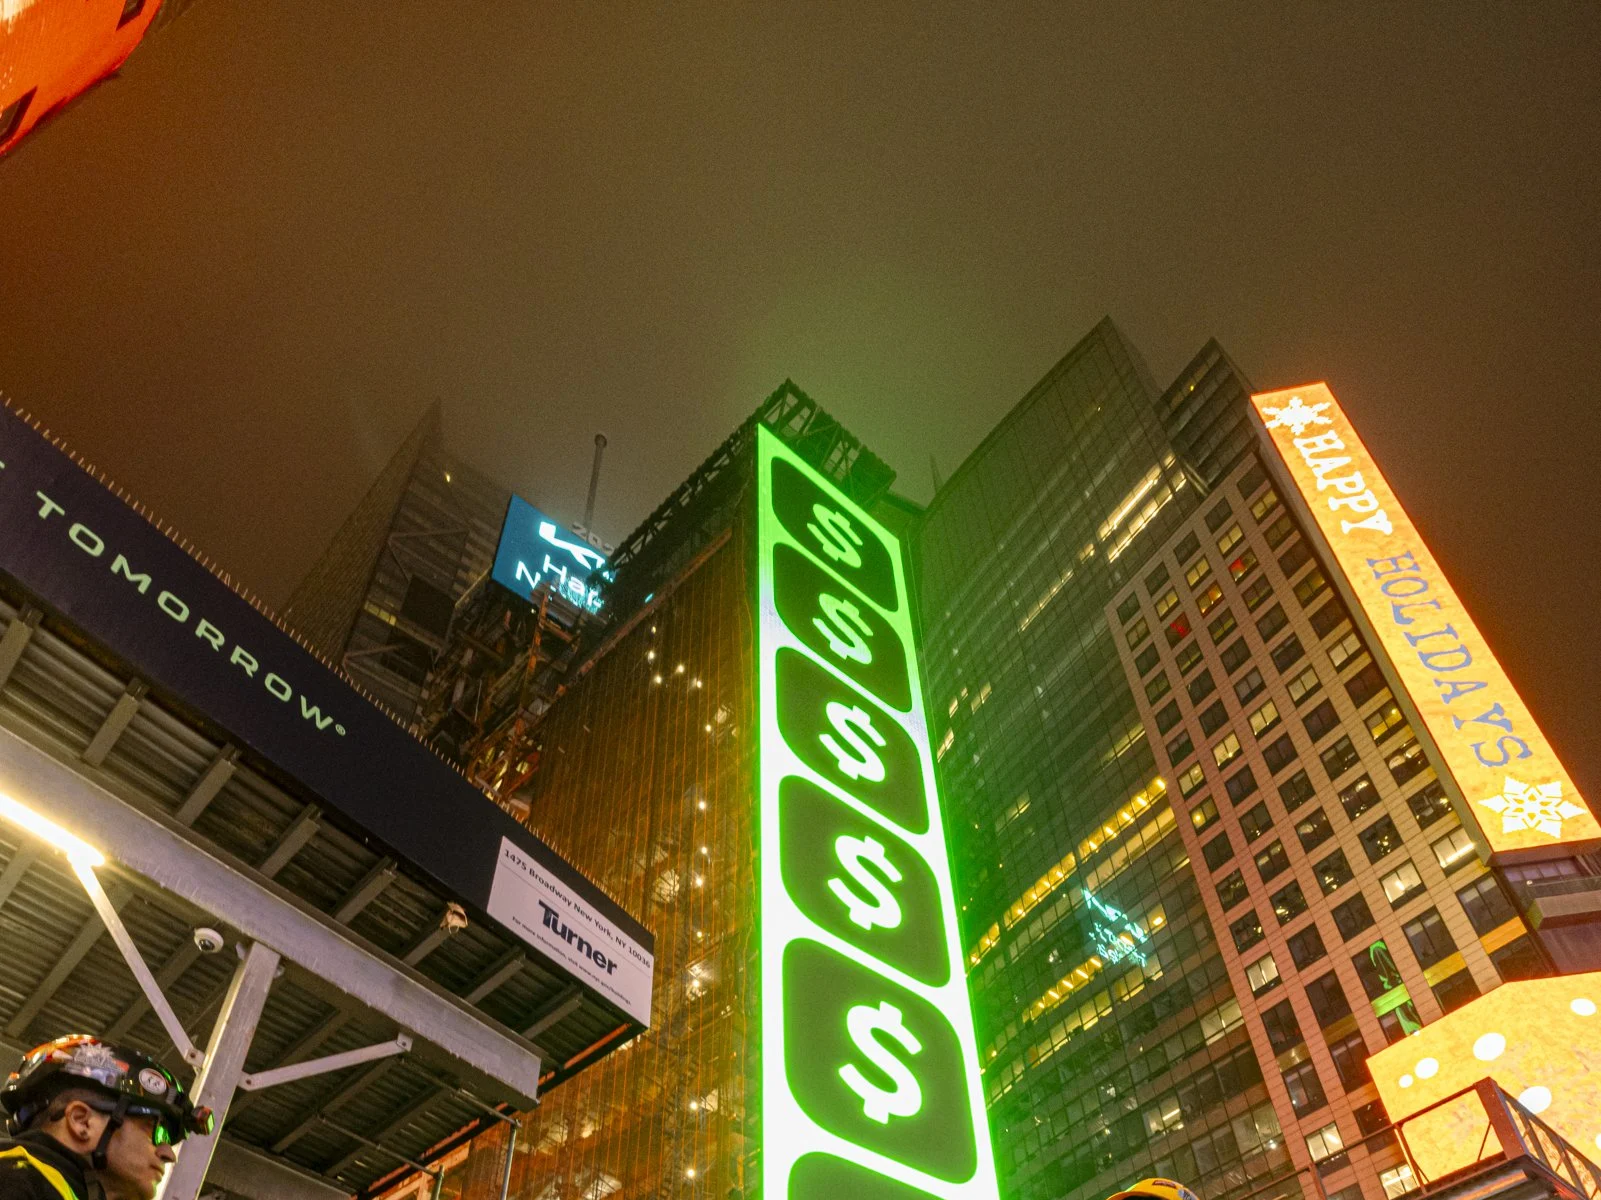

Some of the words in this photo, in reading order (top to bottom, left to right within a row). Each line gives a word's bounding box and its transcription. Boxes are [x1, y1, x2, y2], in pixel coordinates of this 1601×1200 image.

[1294, 430, 1393, 535] HAPPY
[1366, 550, 1534, 769] HOLIDAYS
[504, 848, 527, 871] 1475
[529, 867, 572, 907] Broadway
[573, 902, 593, 923] New
[594, 919, 614, 941] York,
[615, 936, 627, 950] NY
[628, 946, 651, 969] 10036
[539, 898, 618, 976] Turner
